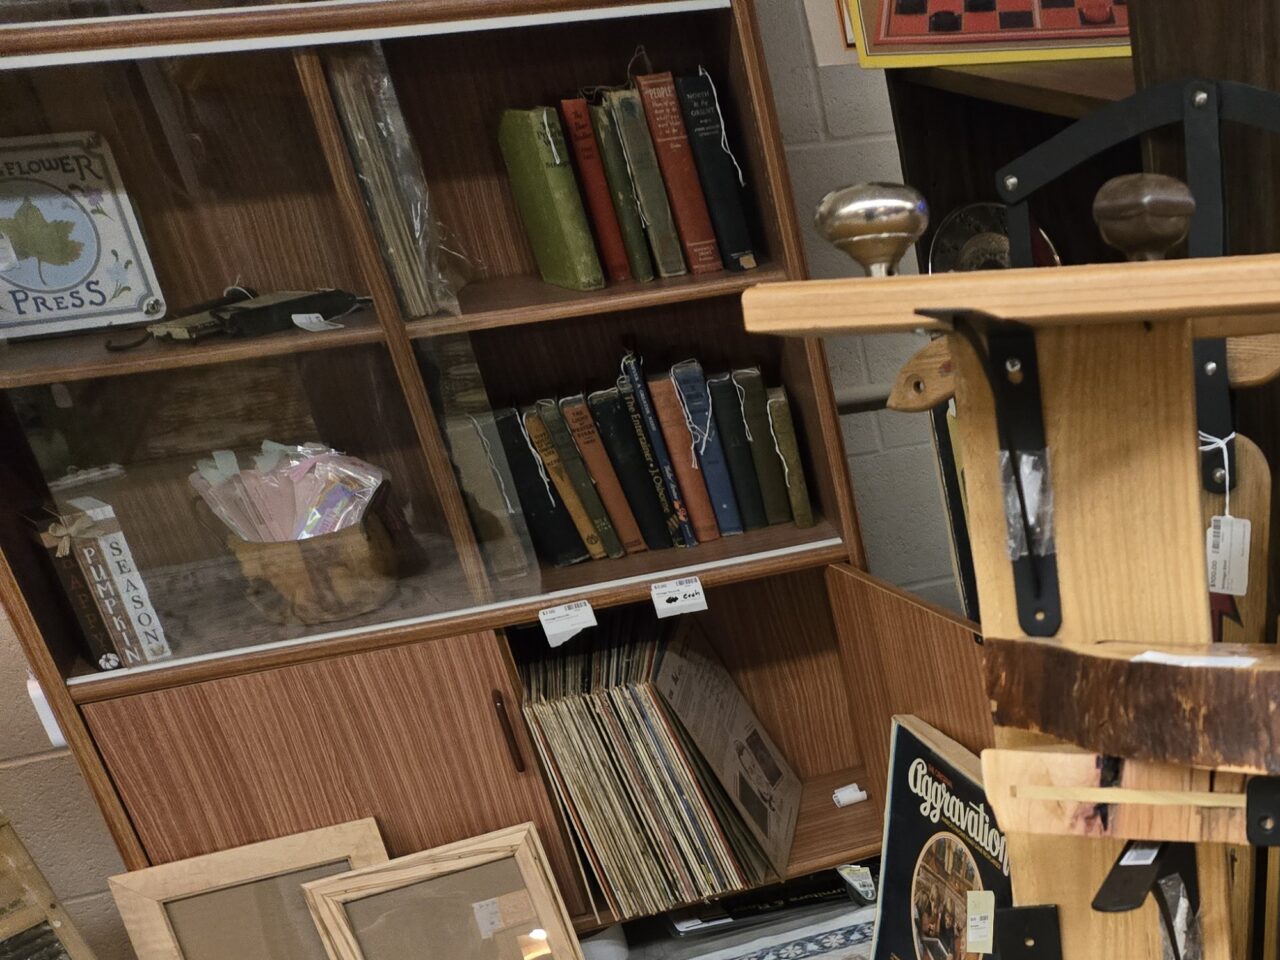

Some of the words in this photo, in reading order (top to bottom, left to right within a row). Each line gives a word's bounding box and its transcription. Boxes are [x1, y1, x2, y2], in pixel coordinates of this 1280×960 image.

[8, 280, 107, 315] PRESS
[624, 393, 638, 414] The
[631, 413, 655, 463] Entertainer
[83, 547, 142, 664] PUMPKIN
[110, 540, 162, 645] SEASON
[907, 757, 1011, 877] Aggravation
